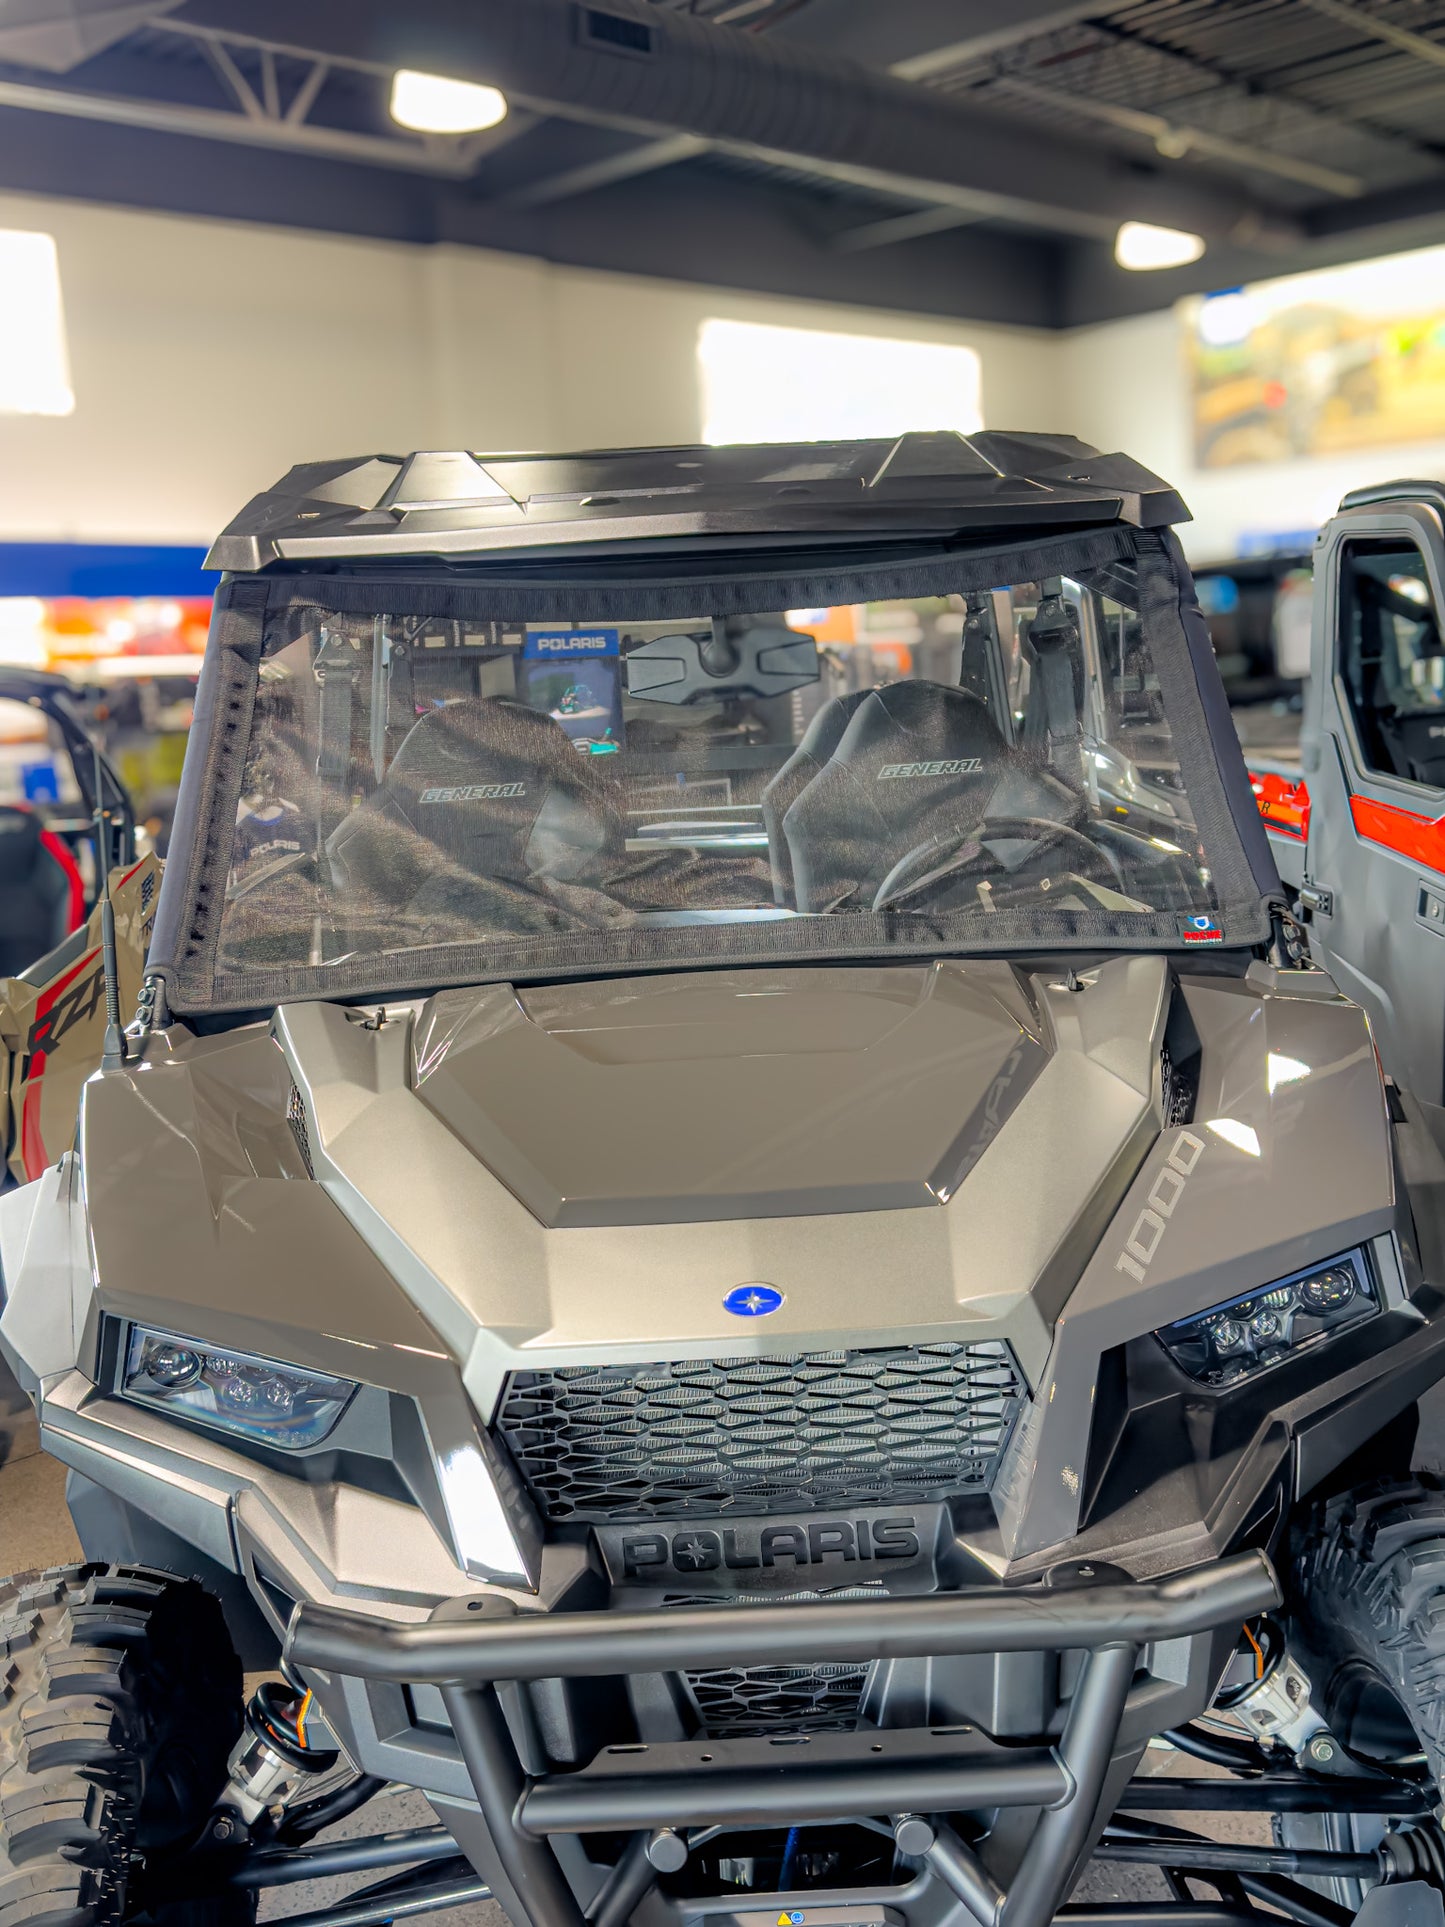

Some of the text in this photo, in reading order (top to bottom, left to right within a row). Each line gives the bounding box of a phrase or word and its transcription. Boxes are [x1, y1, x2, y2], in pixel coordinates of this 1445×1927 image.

[538, 636, 606, 651] POLARIS
[877, 757, 983, 779] GENERAL
[419, 782, 526, 803] GENERAL
[250, 839, 301, 857] POLARIS
[1113, 1131, 1206, 1284] 1000
[622, 1516, 919, 1577] POLARIS
